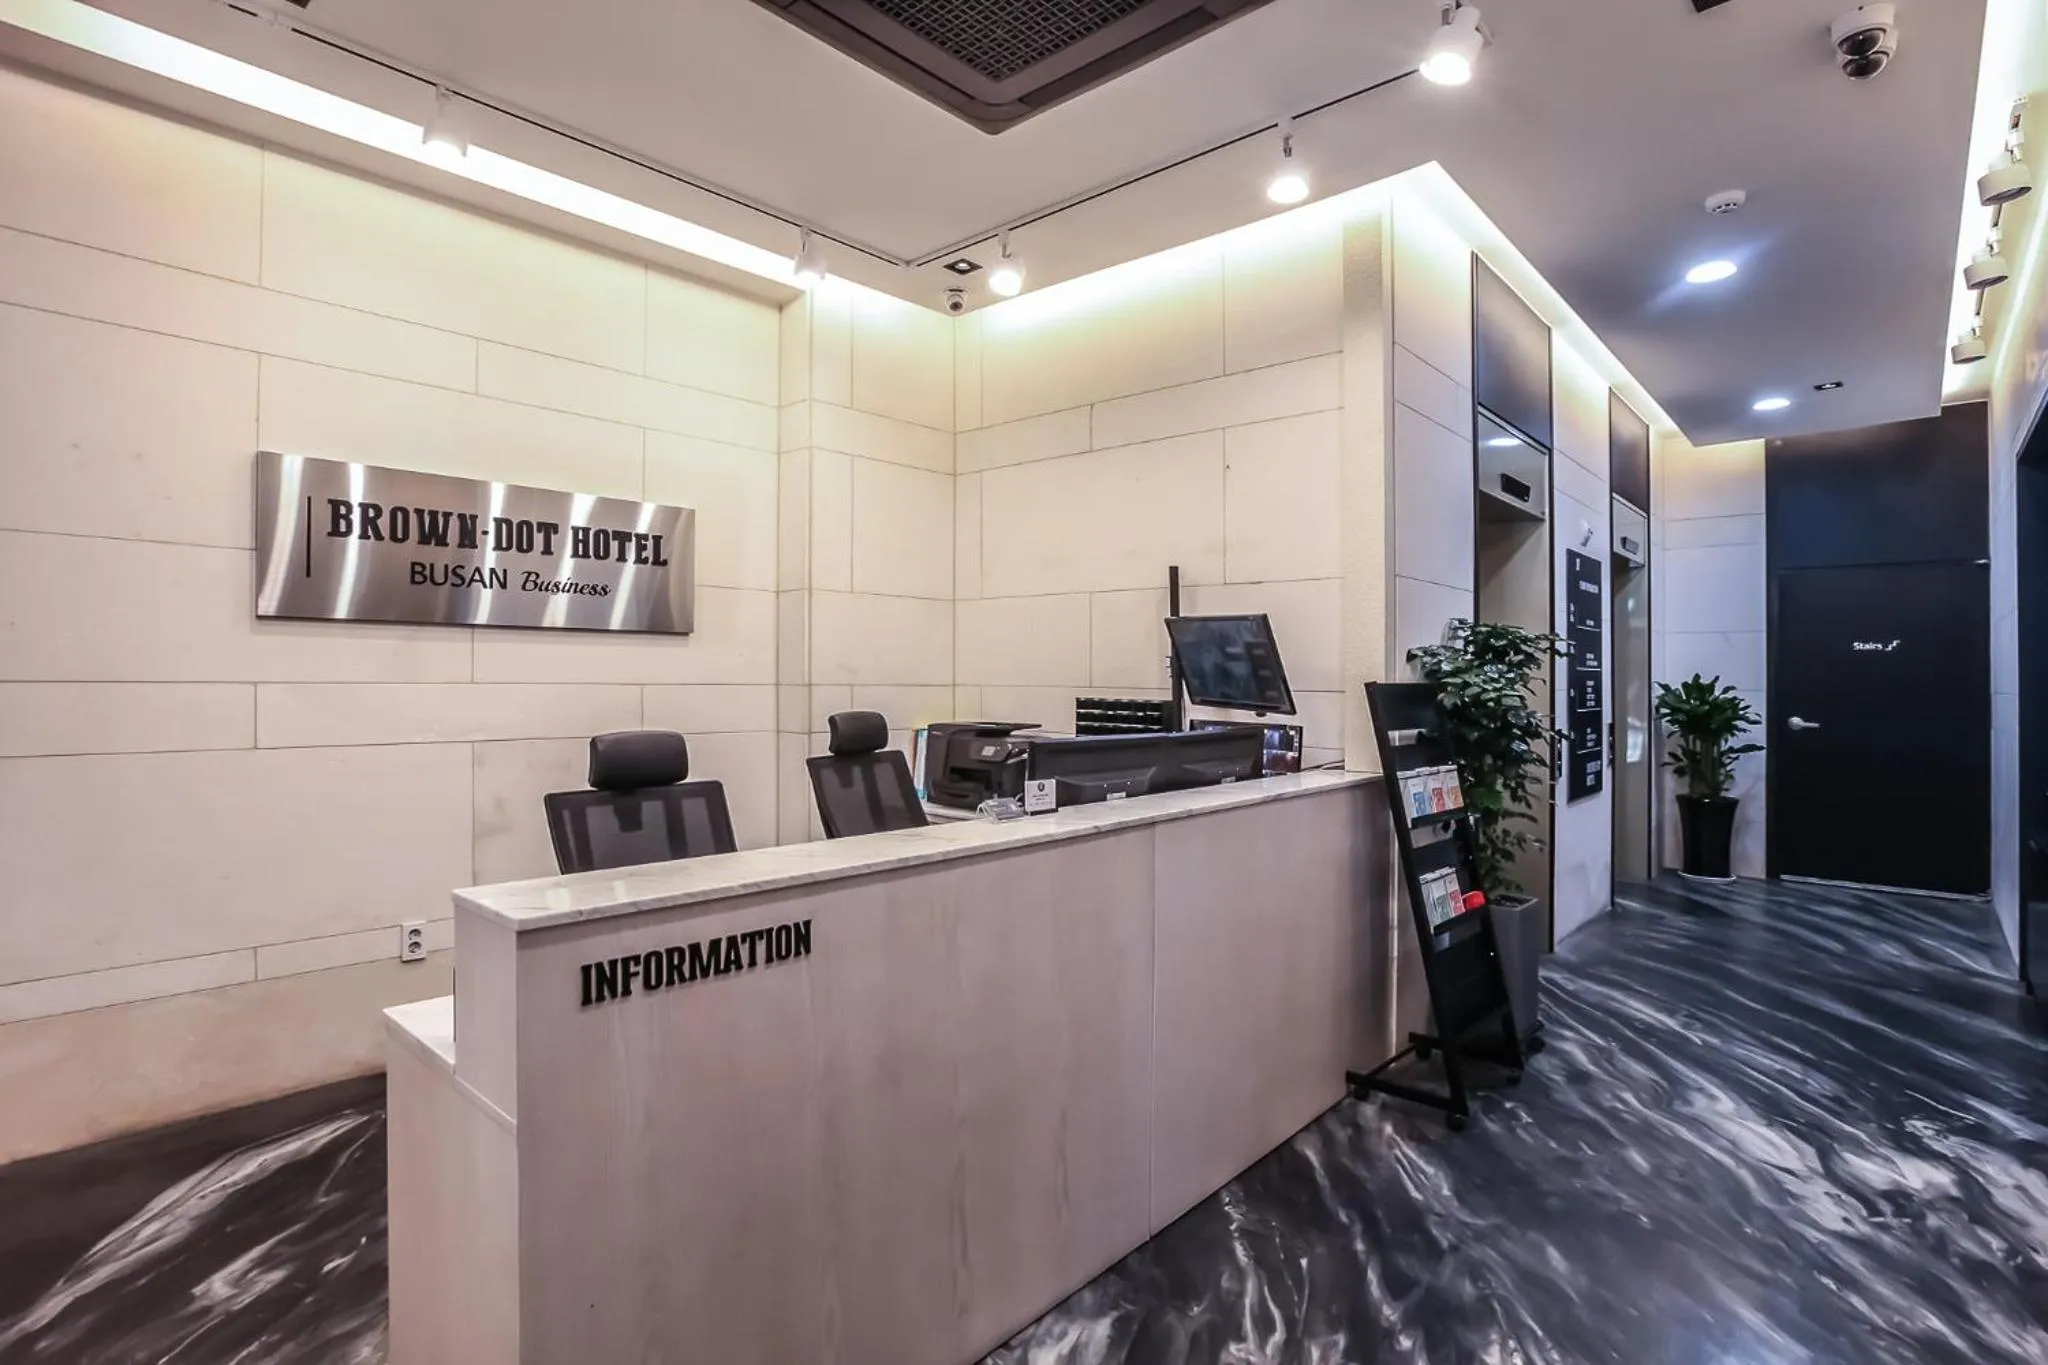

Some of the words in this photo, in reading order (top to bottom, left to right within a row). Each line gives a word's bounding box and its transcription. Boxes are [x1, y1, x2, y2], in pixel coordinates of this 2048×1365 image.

[570, 525, 668, 567] HOTEL
[409, 561, 508, 591] BUSAN
[519, 570, 612, 597] Business
[1853, 642, 1882, 650] Stairs
[580, 919, 812, 1007] INFORMATION
